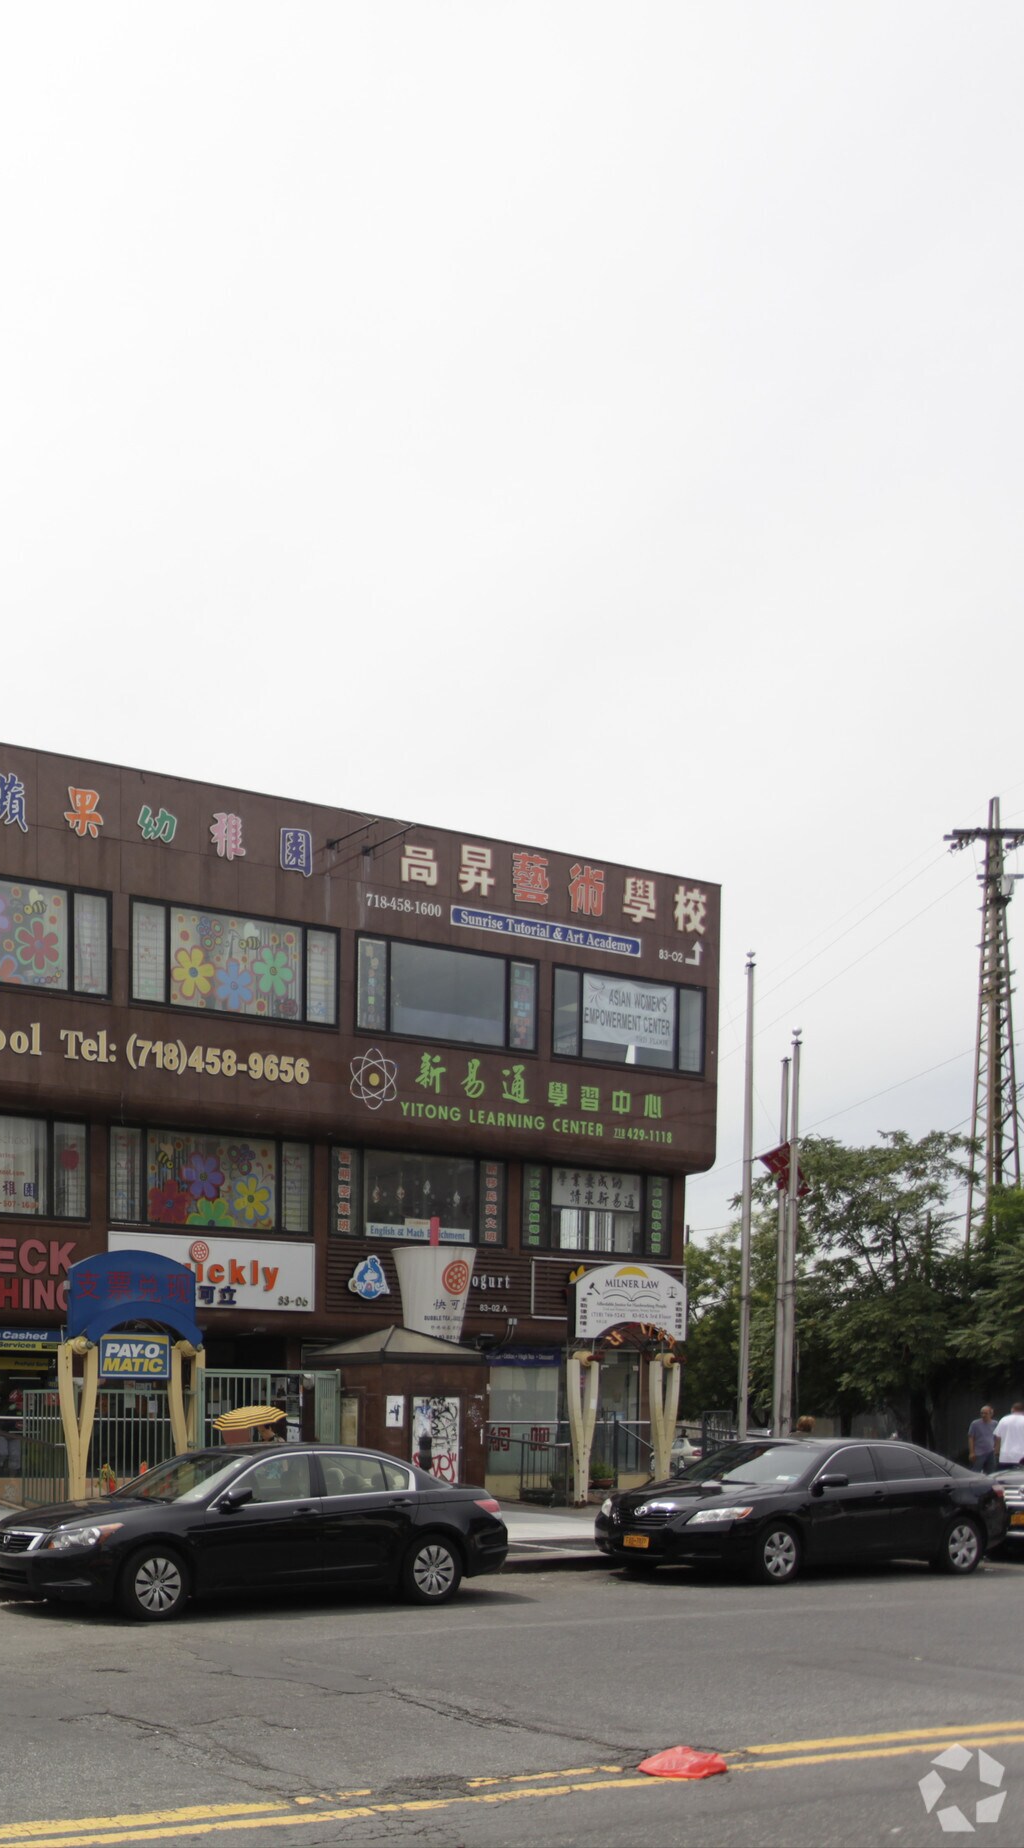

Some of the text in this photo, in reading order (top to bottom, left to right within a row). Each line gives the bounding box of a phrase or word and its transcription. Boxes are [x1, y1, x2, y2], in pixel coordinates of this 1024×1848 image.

[400, 844, 707, 936] 高昇藝術學校
[365, 892, 442, 917] 718-458-1600
[460, 910, 632, 953] Sunrise Tutorial & Art Academy
[658, 949, 683, 963] 83-02
[608, 989, 668, 1013] ASIAN WOMEN'S
[583, 1007, 671, 1037] EMPOWERMENT CENTER
[60, 1029, 117, 1063] Tel:
[126, 1033, 310, 1085] (718)458-9656
[415, 1052, 662, 1119] 新易通學習中心
[400, 1101, 462, 1122] YITONG
[469, 1110, 545, 1131] LEARNING
[552, 1118, 604, 1137] CENTER
[627, 1129, 673, 1144] 429-1118
[370, 1225, 466, 1241] English & Math Eichment
[184, 1258, 280, 1292] ickly
[471, 1274, 510, 1290] ogurt
[605, 1280, 659, 1290] MILNER LAW
[197, 1286, 237, 1305] 可立
[479, 1304, 508, 1313] 83-02 A
[2, 1331, 48, 1340] Cashed
[102, 1358, 164, 1373] MATIC
